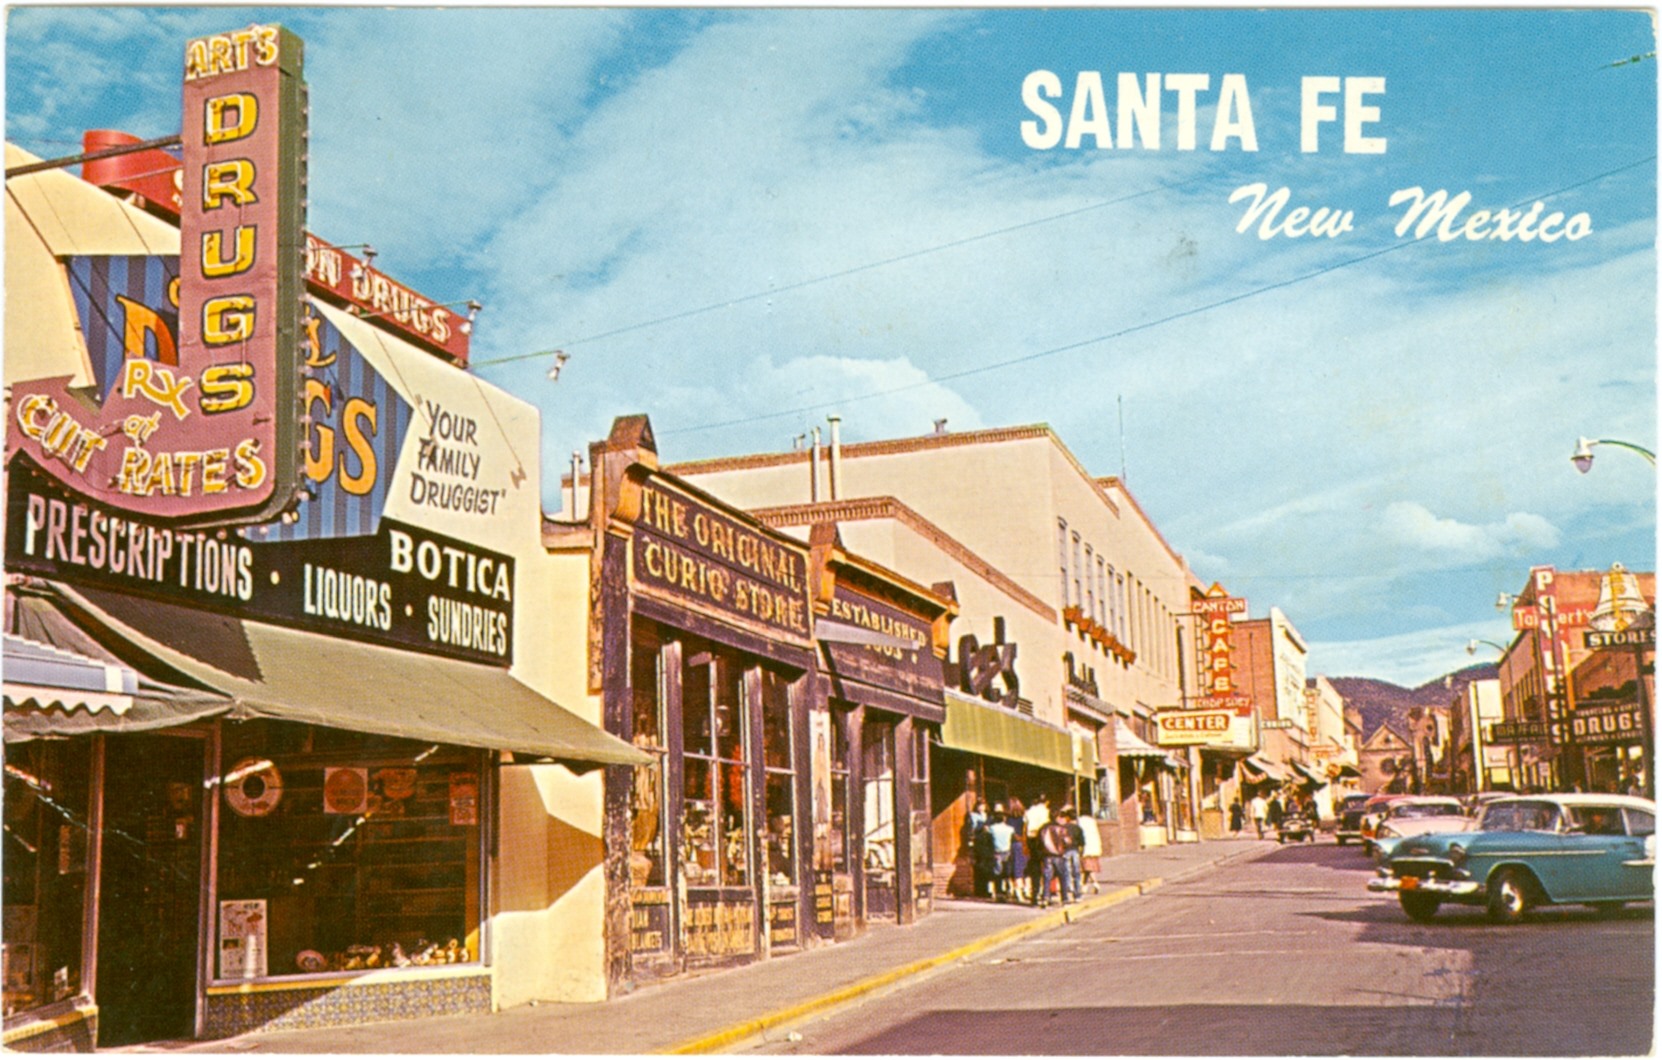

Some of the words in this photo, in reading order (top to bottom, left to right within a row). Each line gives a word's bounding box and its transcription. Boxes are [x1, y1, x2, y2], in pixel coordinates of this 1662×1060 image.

[185, 27, 279, 80] ART'S
[202, 92, 259, 412] DRUGS
[352, 262, 452, 344] DRUGS
[118, 438, 267, 497] RATES
[418, 437, 481, 478] FAMILY
[388, 529, 511, 601] BOTICA
[642, 487, 688, 537] THE
[693, 513, 801, 593] ORIGINAL
[25, 493, 254, 601] PRESCRIPTIONS
[304, 563, 392, 632] LIQUORS
[428, 596, 507, 656] SUNDRIES
[735, 579, 806, 633] STORE
[832, 598, 926, 647] ESTABLISHED
[1192, 600, 1245, 613] CANTON
[1211, 619, 1230, 691] CAFE
[1590, 630, 1656, 647] STORES
[1164, 716, 1227, 731] CENTER
[1573, 710, 1643, 736] DRUGS
